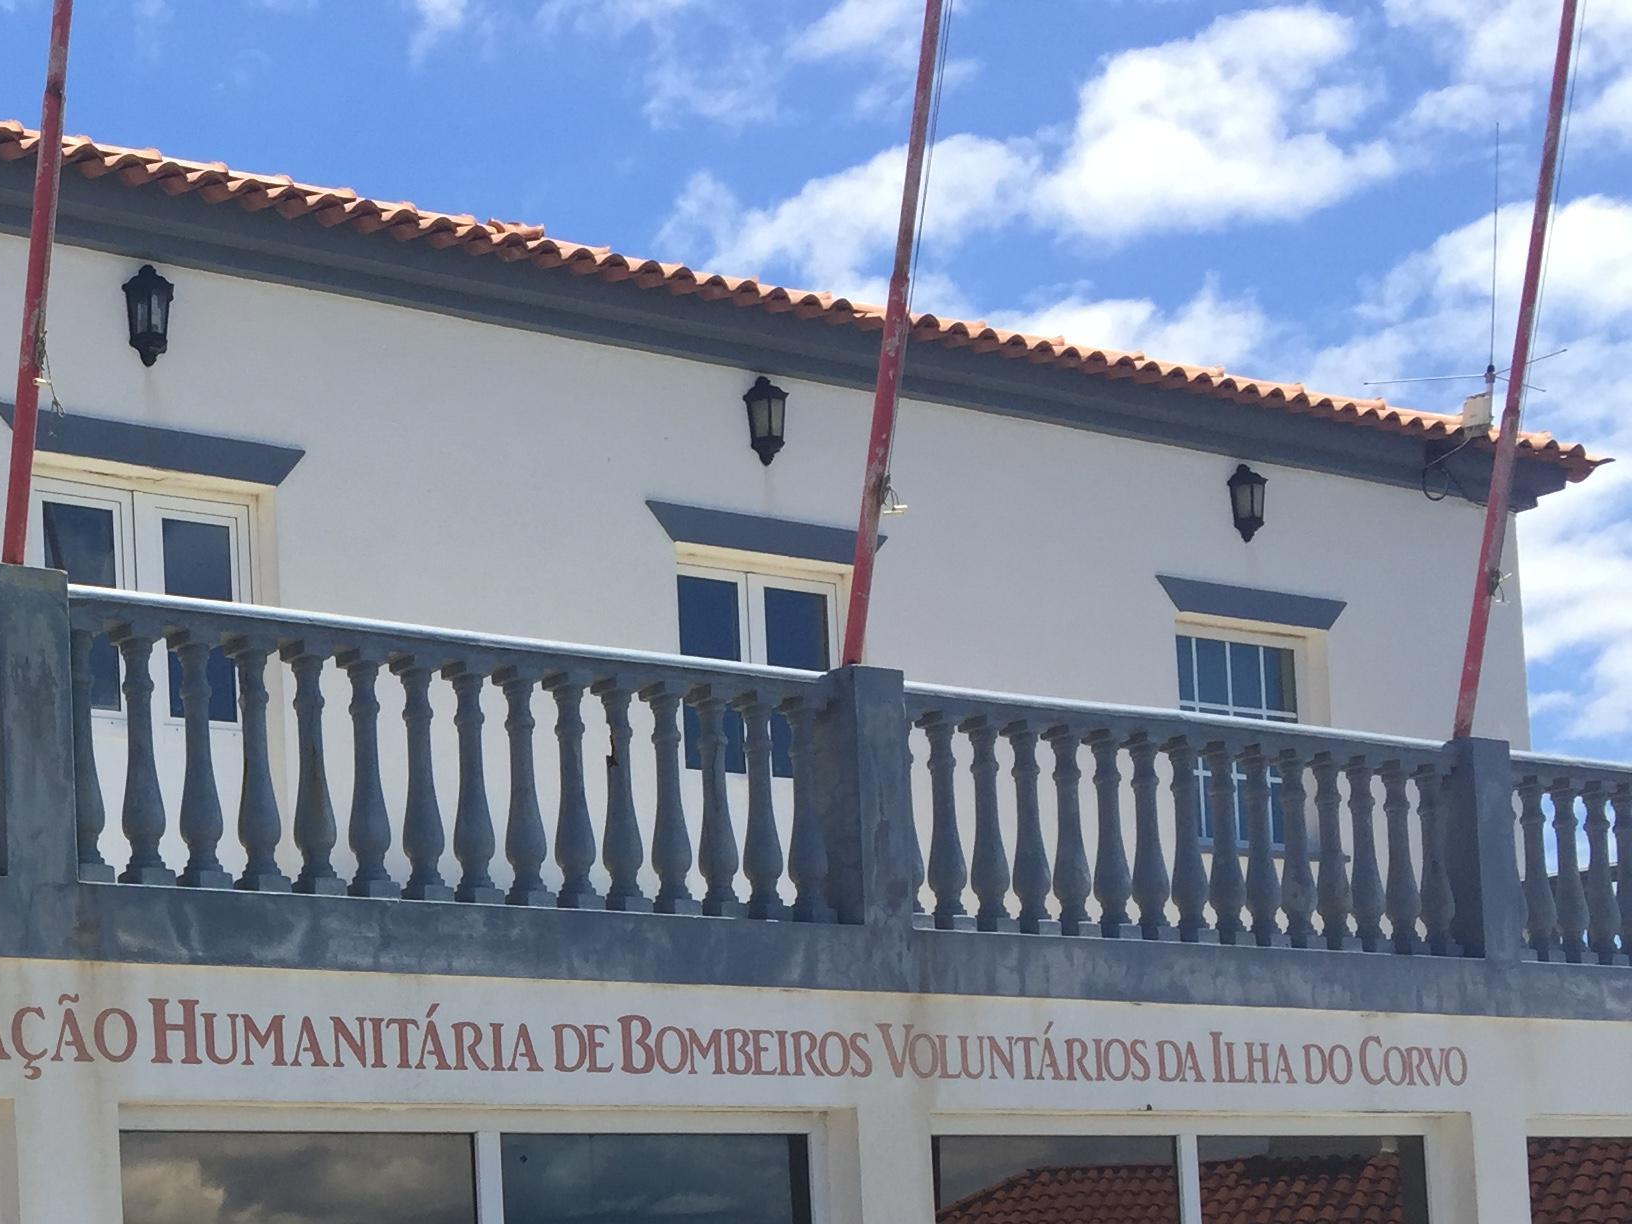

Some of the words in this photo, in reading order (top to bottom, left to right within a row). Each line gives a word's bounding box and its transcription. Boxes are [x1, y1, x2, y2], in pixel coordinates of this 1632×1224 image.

[148, 998, 544, 1073] HUMANITÁRIA
[551, 1022, 613, 1074] DE
[618, 1013, 872, 1079] BOMBEIROS
[875, 1020, 1151, 1083] VOLUNTÁRIOS
[1156, 1038, 1206, 1084] DA
[1210, 1030, 1297, 1085] ILHA
[1303, 1042, 1354, 1085] DO
[1358, 1035, 1469, 1087] CORVO
